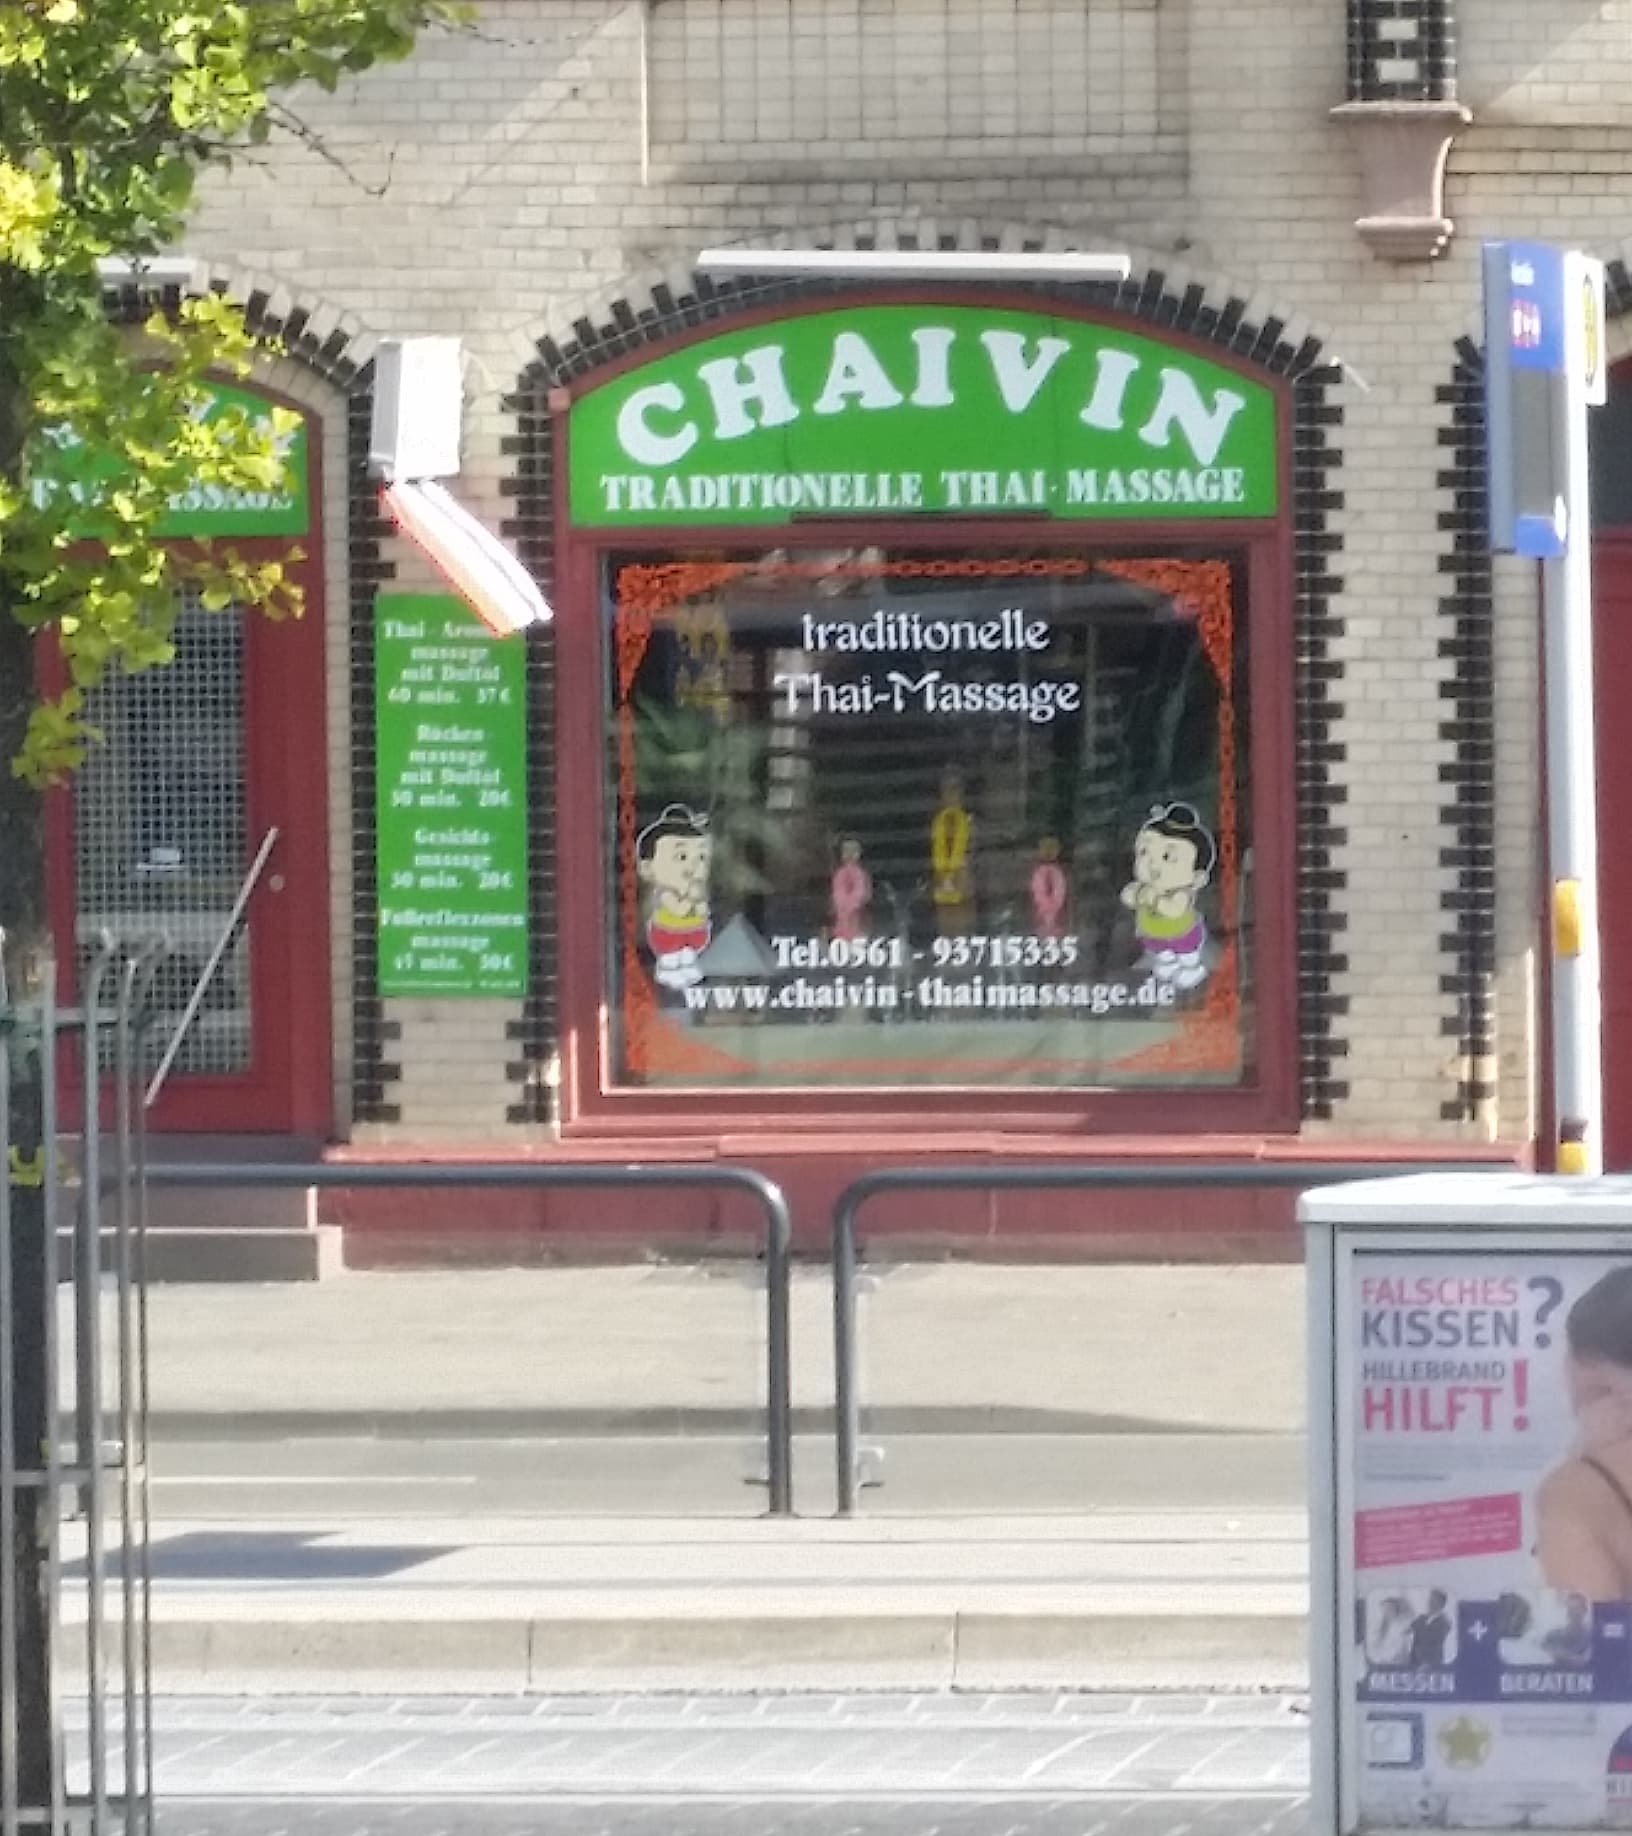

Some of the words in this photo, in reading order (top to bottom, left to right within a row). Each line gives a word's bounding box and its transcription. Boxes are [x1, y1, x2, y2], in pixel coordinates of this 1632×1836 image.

[616, 326, 1246, 466] CHAIVIN
[602, 473, 922, 512] TRADITIONELLE
[802, 609, 1050, 652] traditionelle
[774, 670, 1081, 723] Thai-Massage
[932, 935, 1078, 968] 93715335
[1361, 1277, 1519, 1306] FALSCHES
[1362, 1360, 1505, 1381] HILLEBRAND
